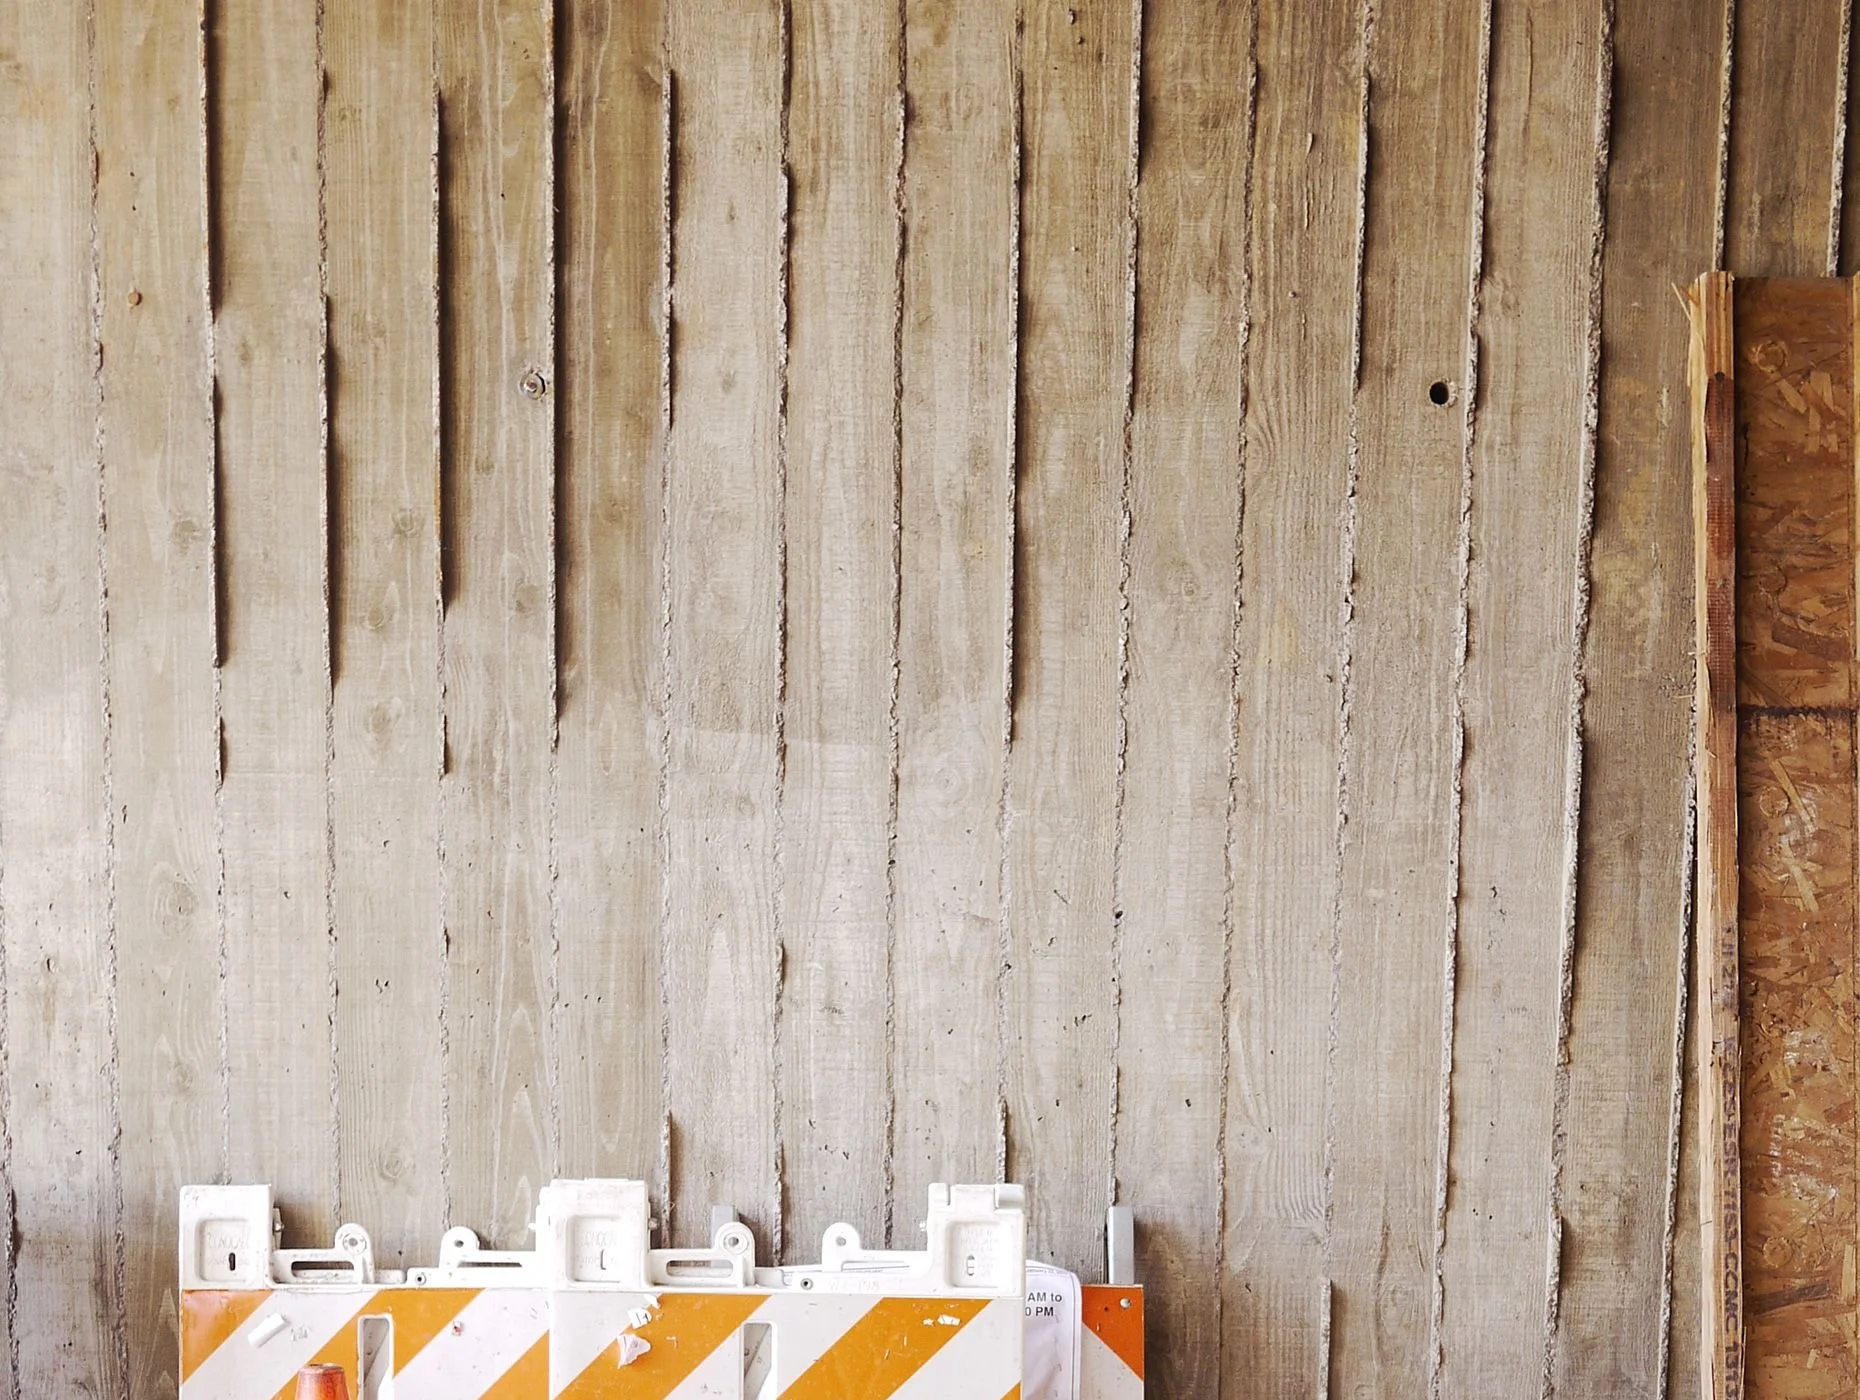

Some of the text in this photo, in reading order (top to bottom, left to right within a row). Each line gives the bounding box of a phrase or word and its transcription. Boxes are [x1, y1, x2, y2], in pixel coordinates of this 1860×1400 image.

[1027, 1291, 1062, 1302] AM to
[1035, 1306, 1054, 1317] PM
